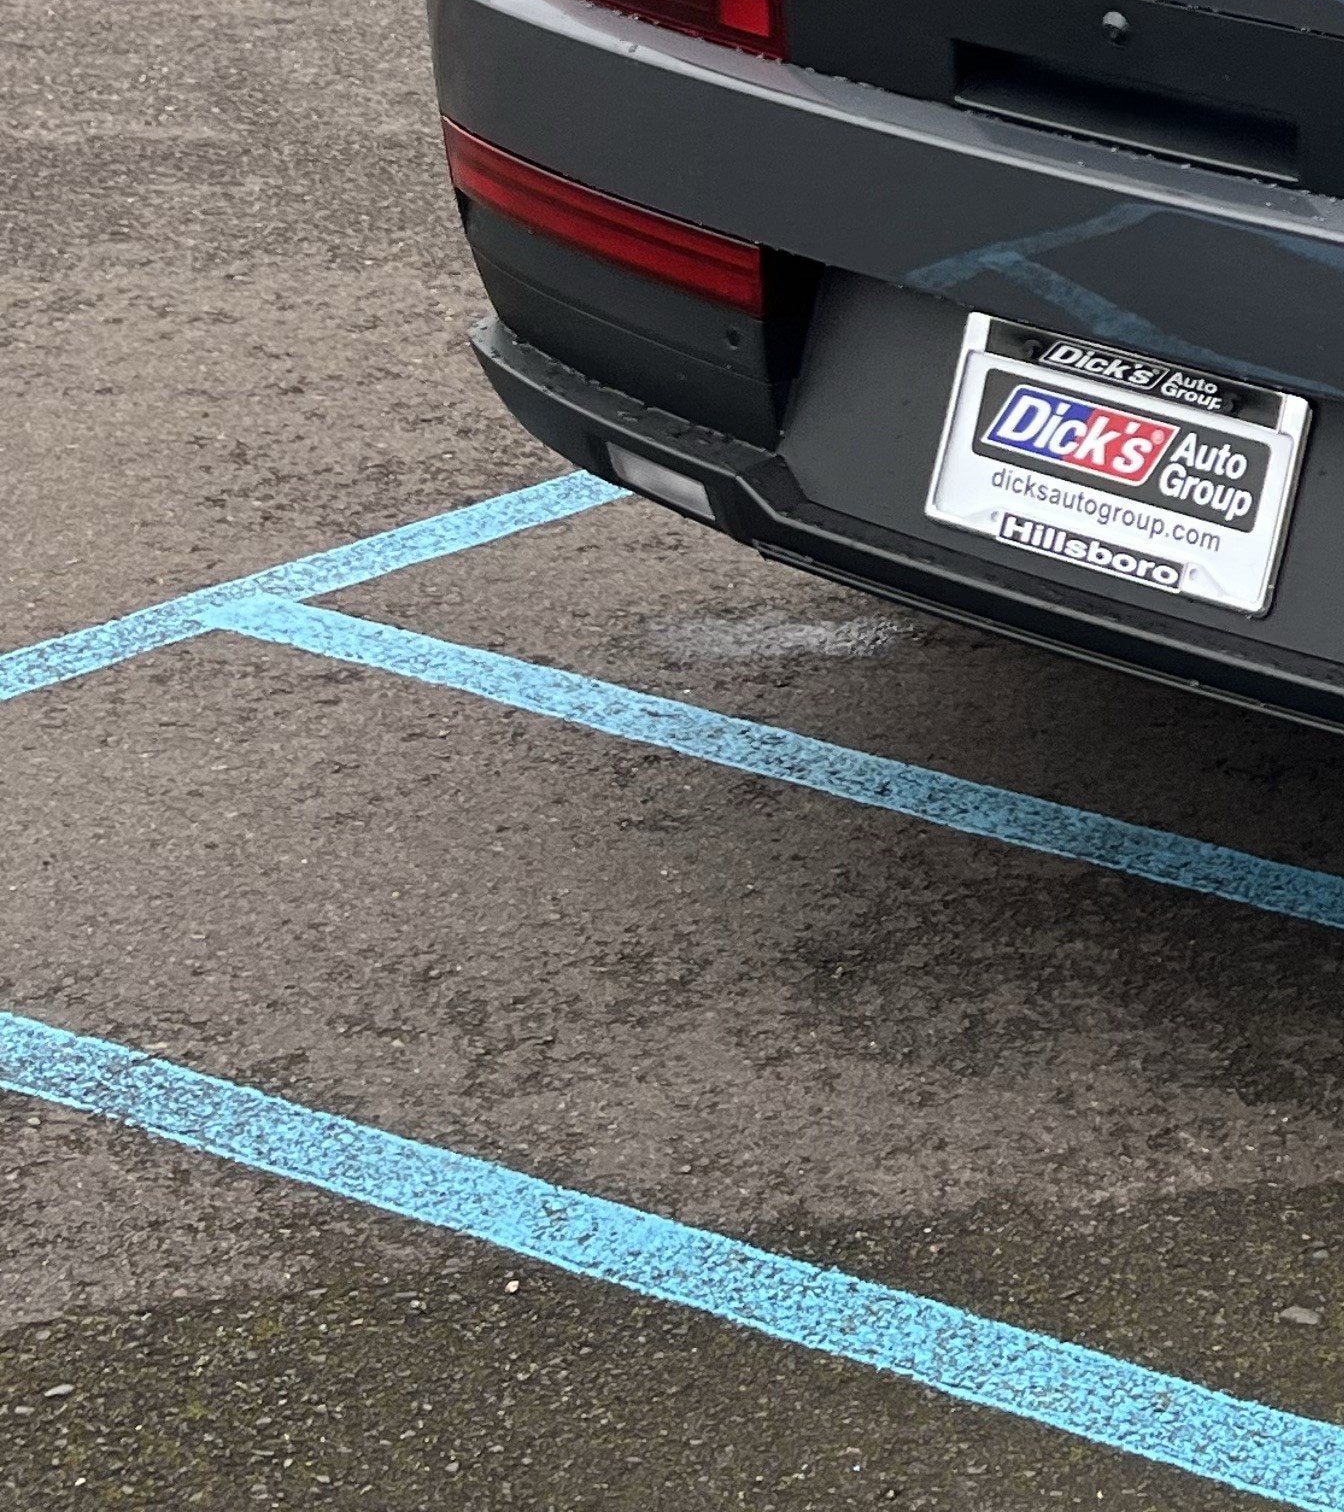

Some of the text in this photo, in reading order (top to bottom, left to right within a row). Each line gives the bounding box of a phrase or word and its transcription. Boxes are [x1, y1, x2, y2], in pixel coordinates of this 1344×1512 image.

[1049, 344, 1218, 394] Dick's Auto
[997, 393, 1247, 479] Dick's Auto
[991, 467, 1221, 552] dicksautogroup.com
[1159, 464, 1252, 522] Group
[1002, 513, 1180, 586] Hillsboro
